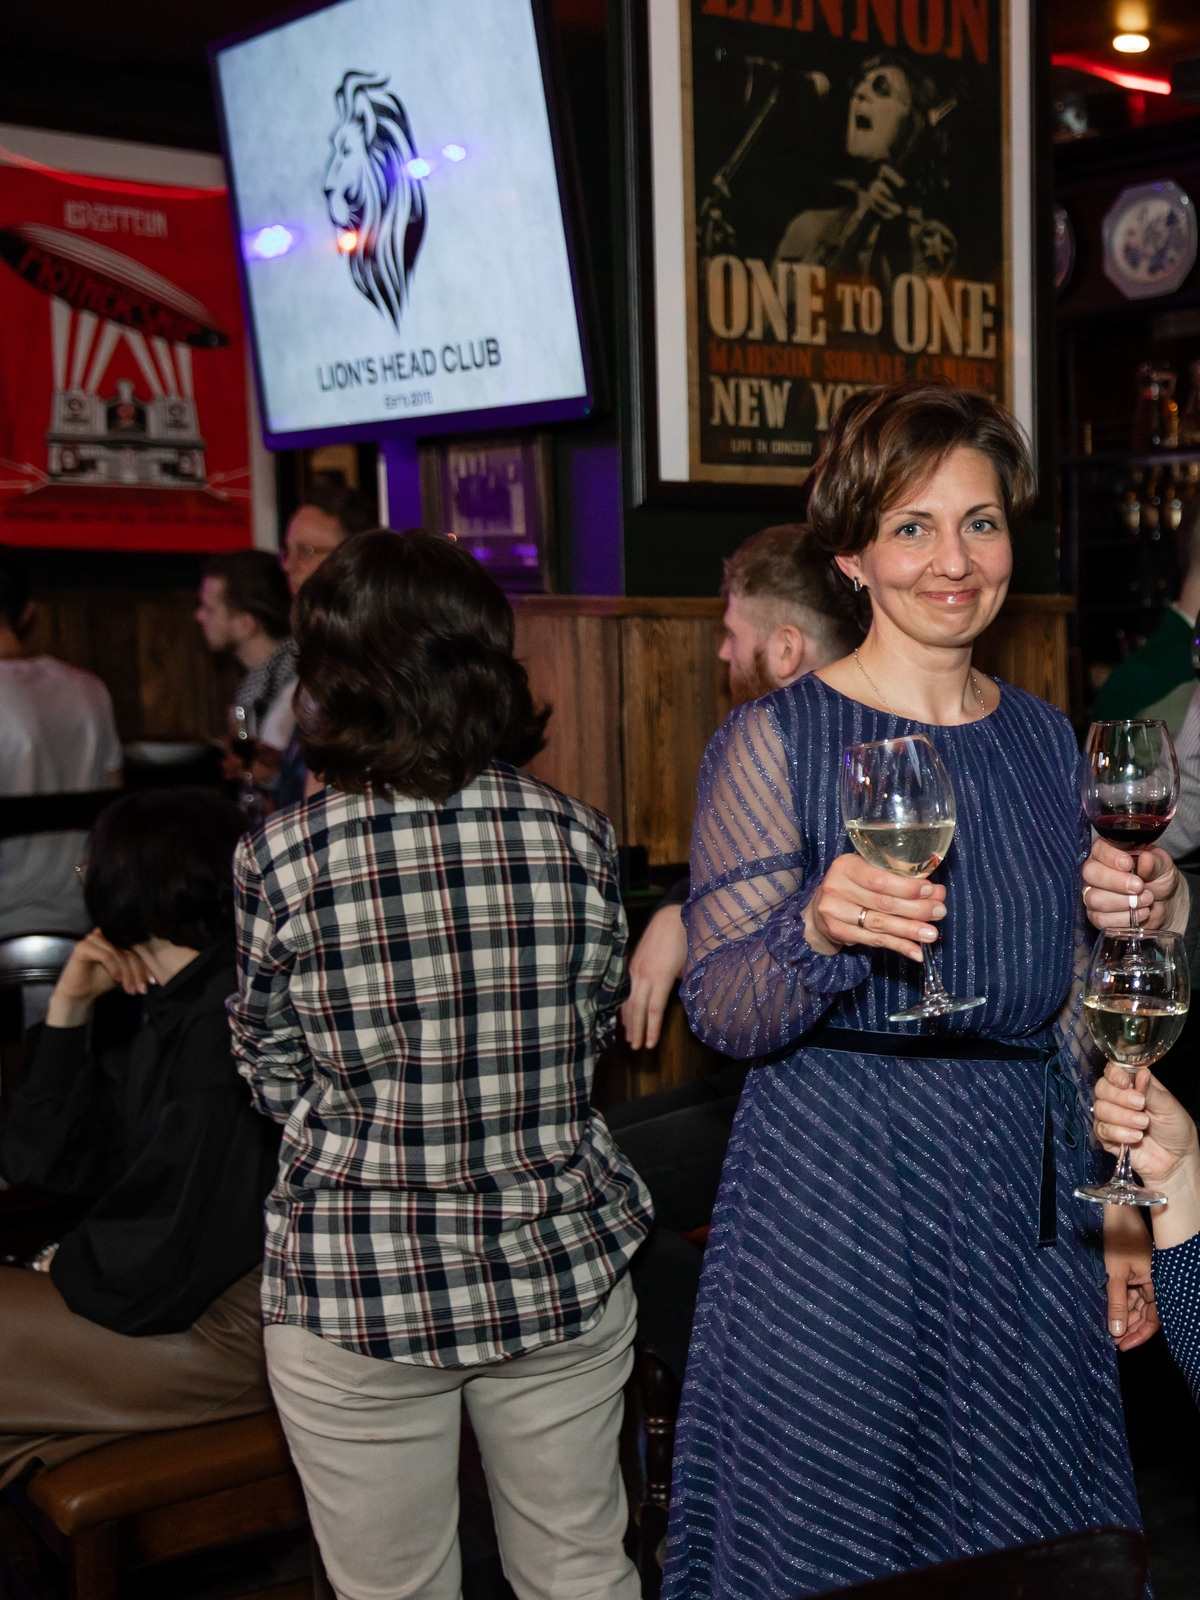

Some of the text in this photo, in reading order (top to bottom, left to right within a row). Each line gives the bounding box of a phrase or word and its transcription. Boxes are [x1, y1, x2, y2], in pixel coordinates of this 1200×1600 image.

[707, 253, 997, 359] ONE TO ONE
[318, 338, 503, 392] LION'S HEAD CLUB
[708, 375, 792, 429] NEW
[730, 438, 813, 456] LIVE IN CONCERT
